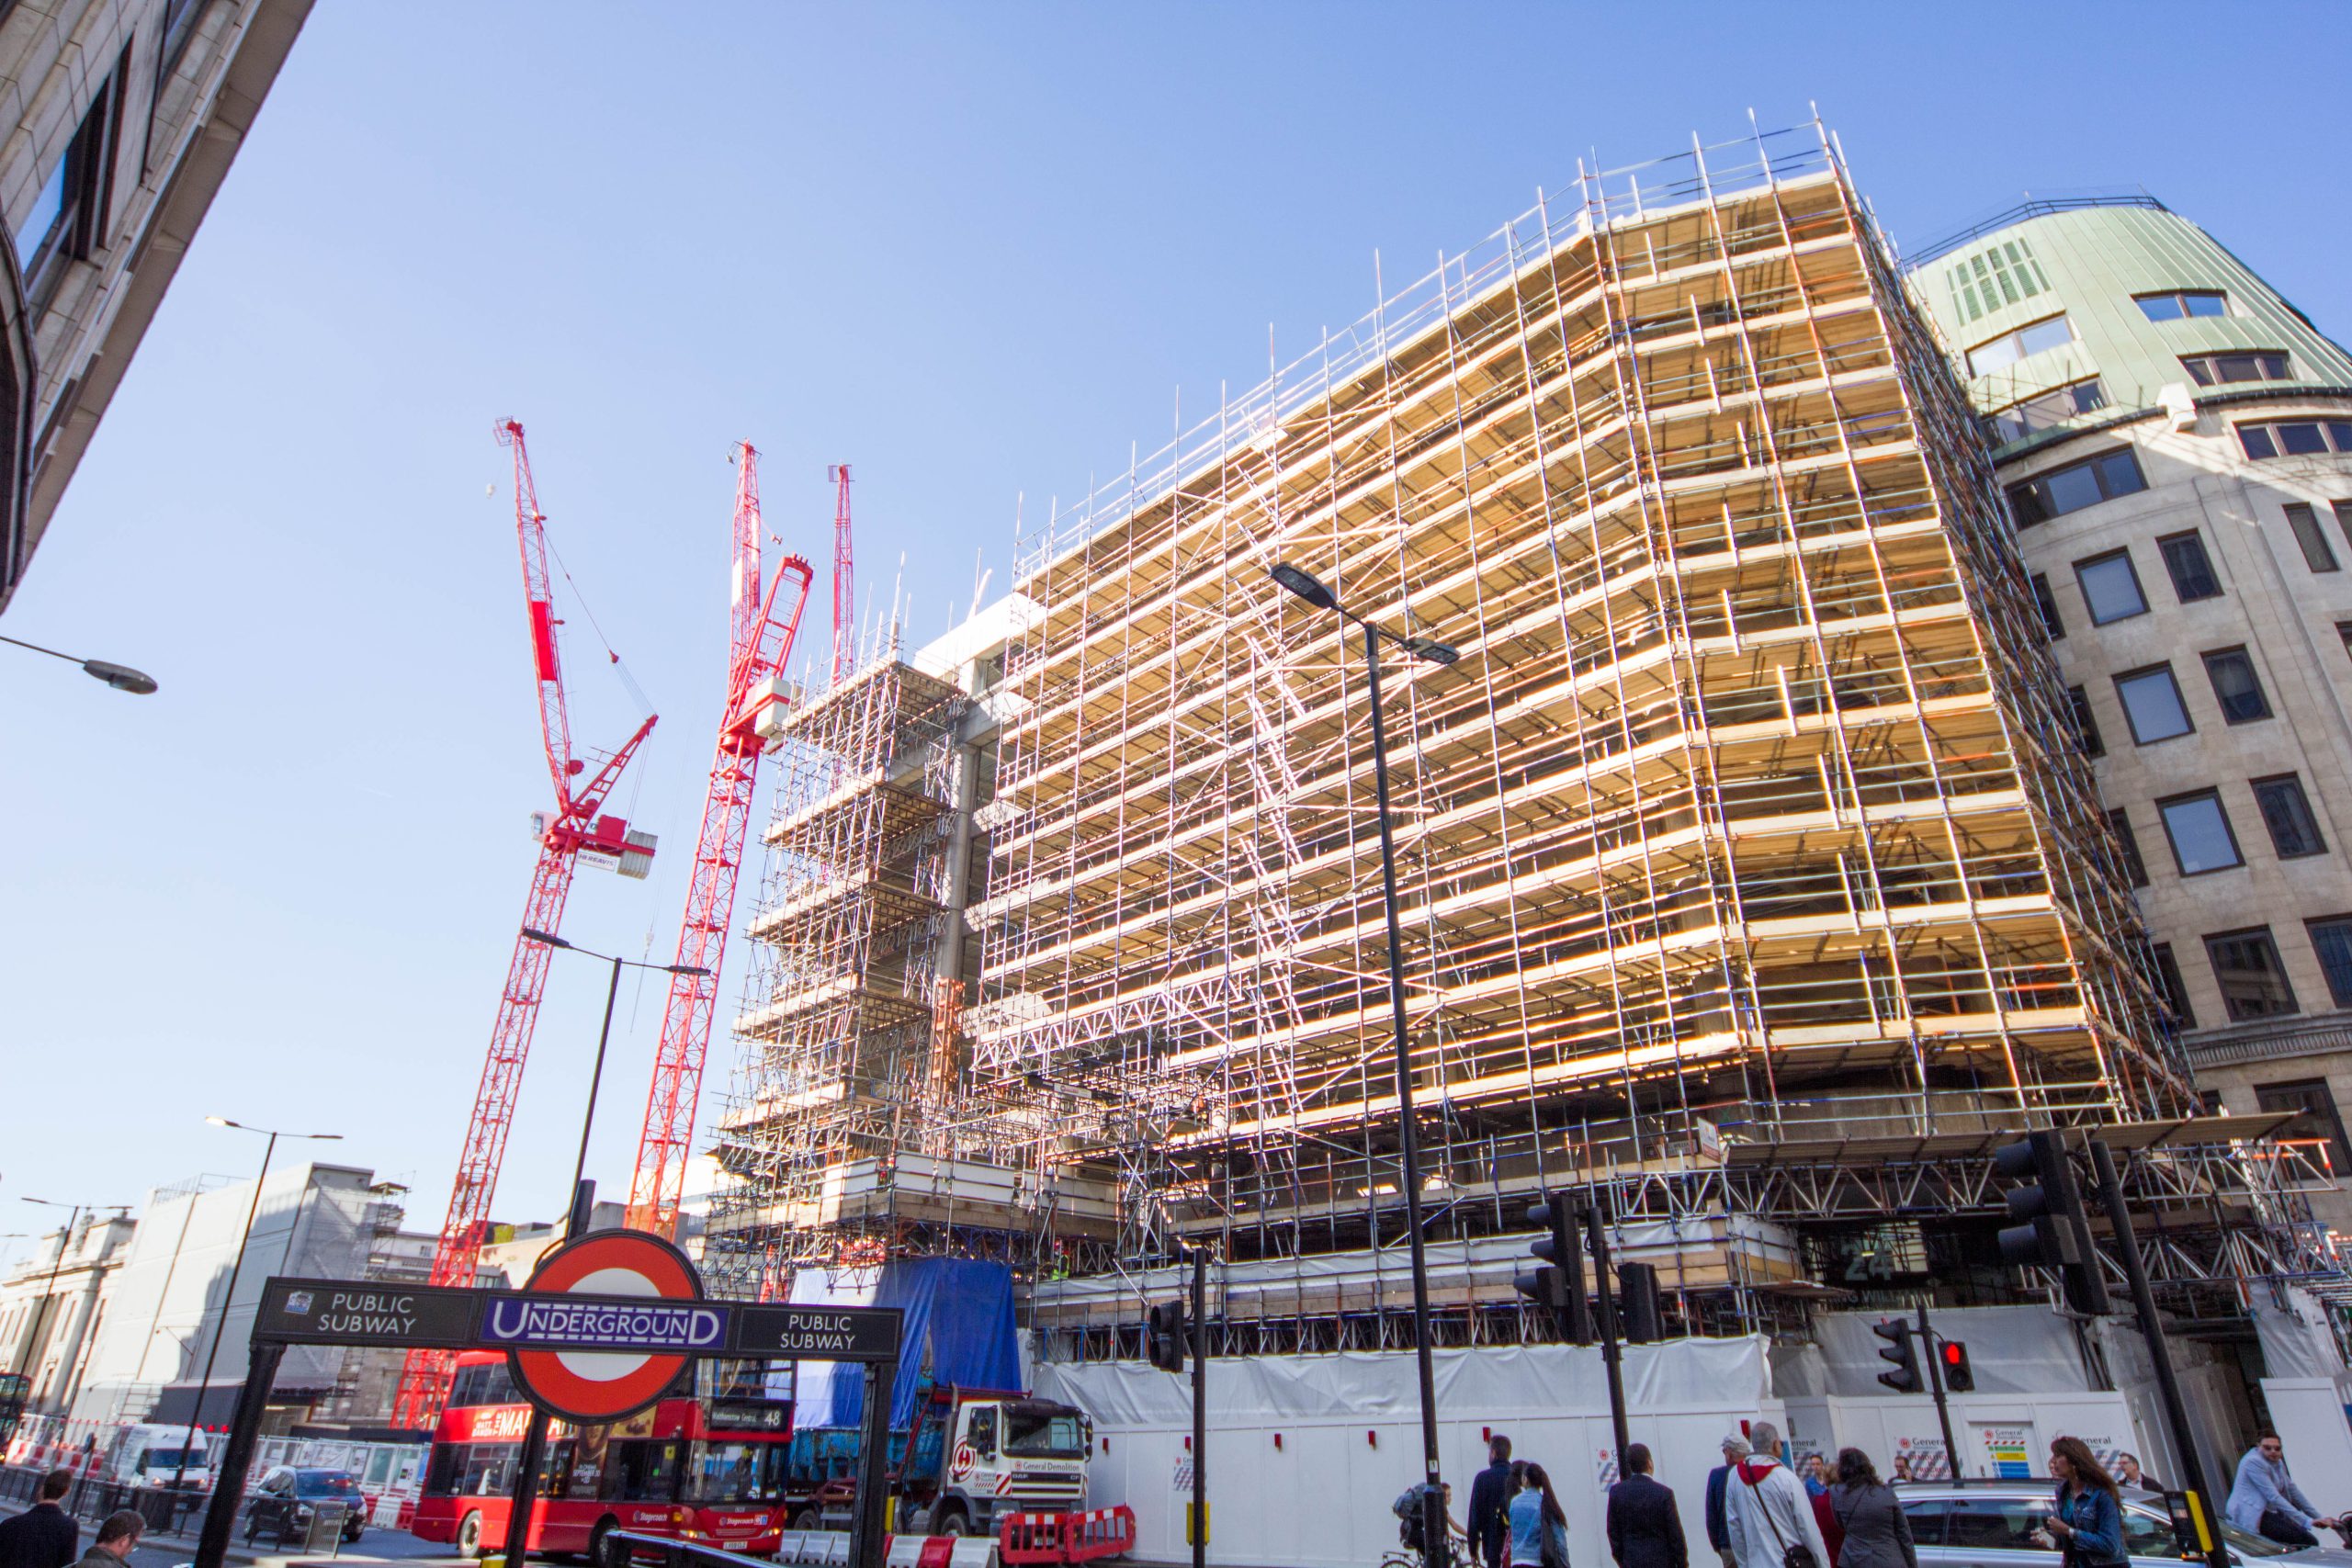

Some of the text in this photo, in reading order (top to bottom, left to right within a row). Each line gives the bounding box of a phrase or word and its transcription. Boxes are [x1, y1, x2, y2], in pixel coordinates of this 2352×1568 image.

[1841, 1236, 1894, 1280] 24
[332, 1293, 413, 1314] PUBLIC
[318, 1314, 416, 1335] SUBWAY
[492, 1301, 719, 1345] UNDERGROUND
[789, 1314, 852, 1332] PUBLIC
[780, 1333, 855, 1350] SUBWAY
[764, 1410, 781, 1427] 48
[1792, 1438, 1817, 1447] eneral
[1912, 1438, 1945, 1446] Genera
[2081, 1436, 2111, 1445] eneral
[1047, 1462, 1080, 1472] Demolition
[639, 1512, 668, 1523] Stagecoach
